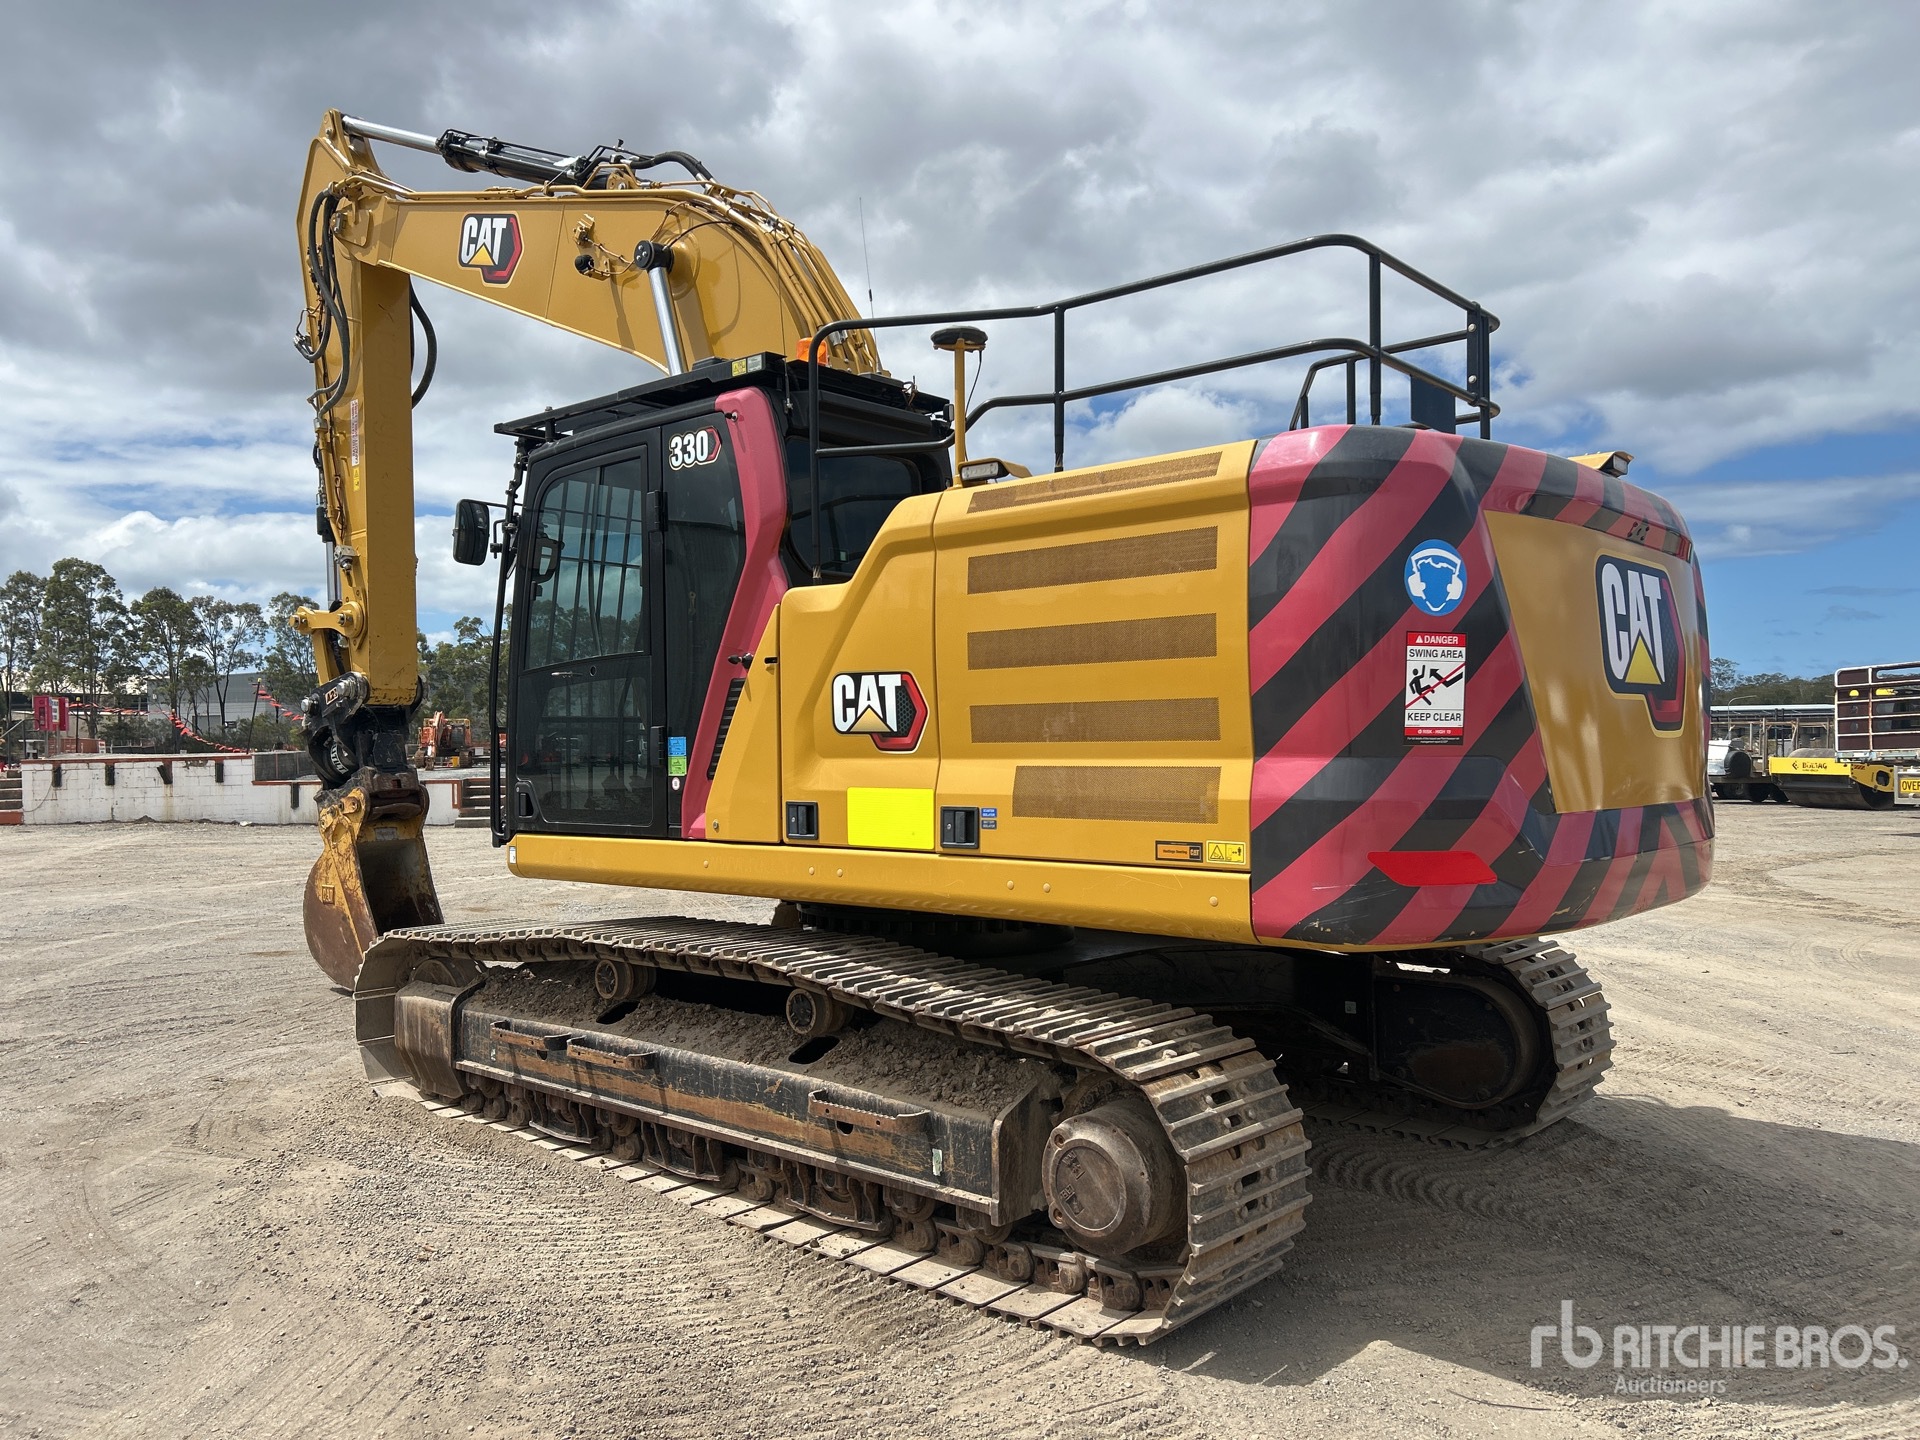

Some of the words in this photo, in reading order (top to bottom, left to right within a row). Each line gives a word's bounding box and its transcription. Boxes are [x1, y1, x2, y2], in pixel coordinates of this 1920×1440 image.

[461, 217, 508, 265] CAT
[671, 430, 709, 467] 330
[1424, 635, 1459, 645] DANGER
[1602, 562, 1666, 682] CAT
[1409, 648, 1438, 658] SWING
[1440, 649, 1464, 659] AREA
[833, 674, 902, 732] CAT
[1407, 712, 1431, 722] KEEP
[1433, 712, 1462, 722] CLEAR
